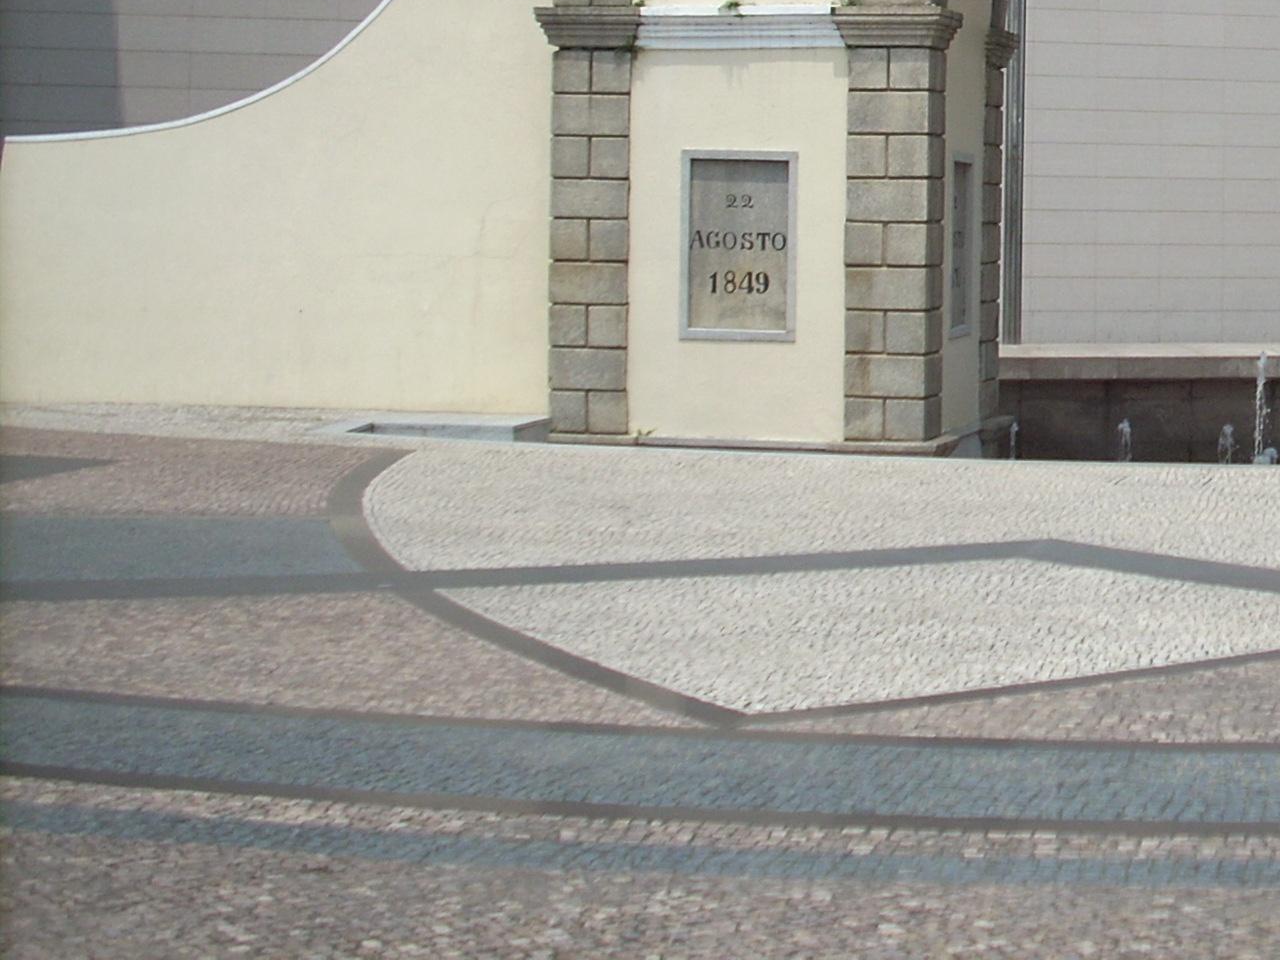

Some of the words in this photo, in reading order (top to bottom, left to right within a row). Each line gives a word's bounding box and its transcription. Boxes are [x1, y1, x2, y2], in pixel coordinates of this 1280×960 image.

[726, 194, 754, 209] 22
[691, 230, 787, 251] AGOSTO
[709, 270, 770, 294] 1849
